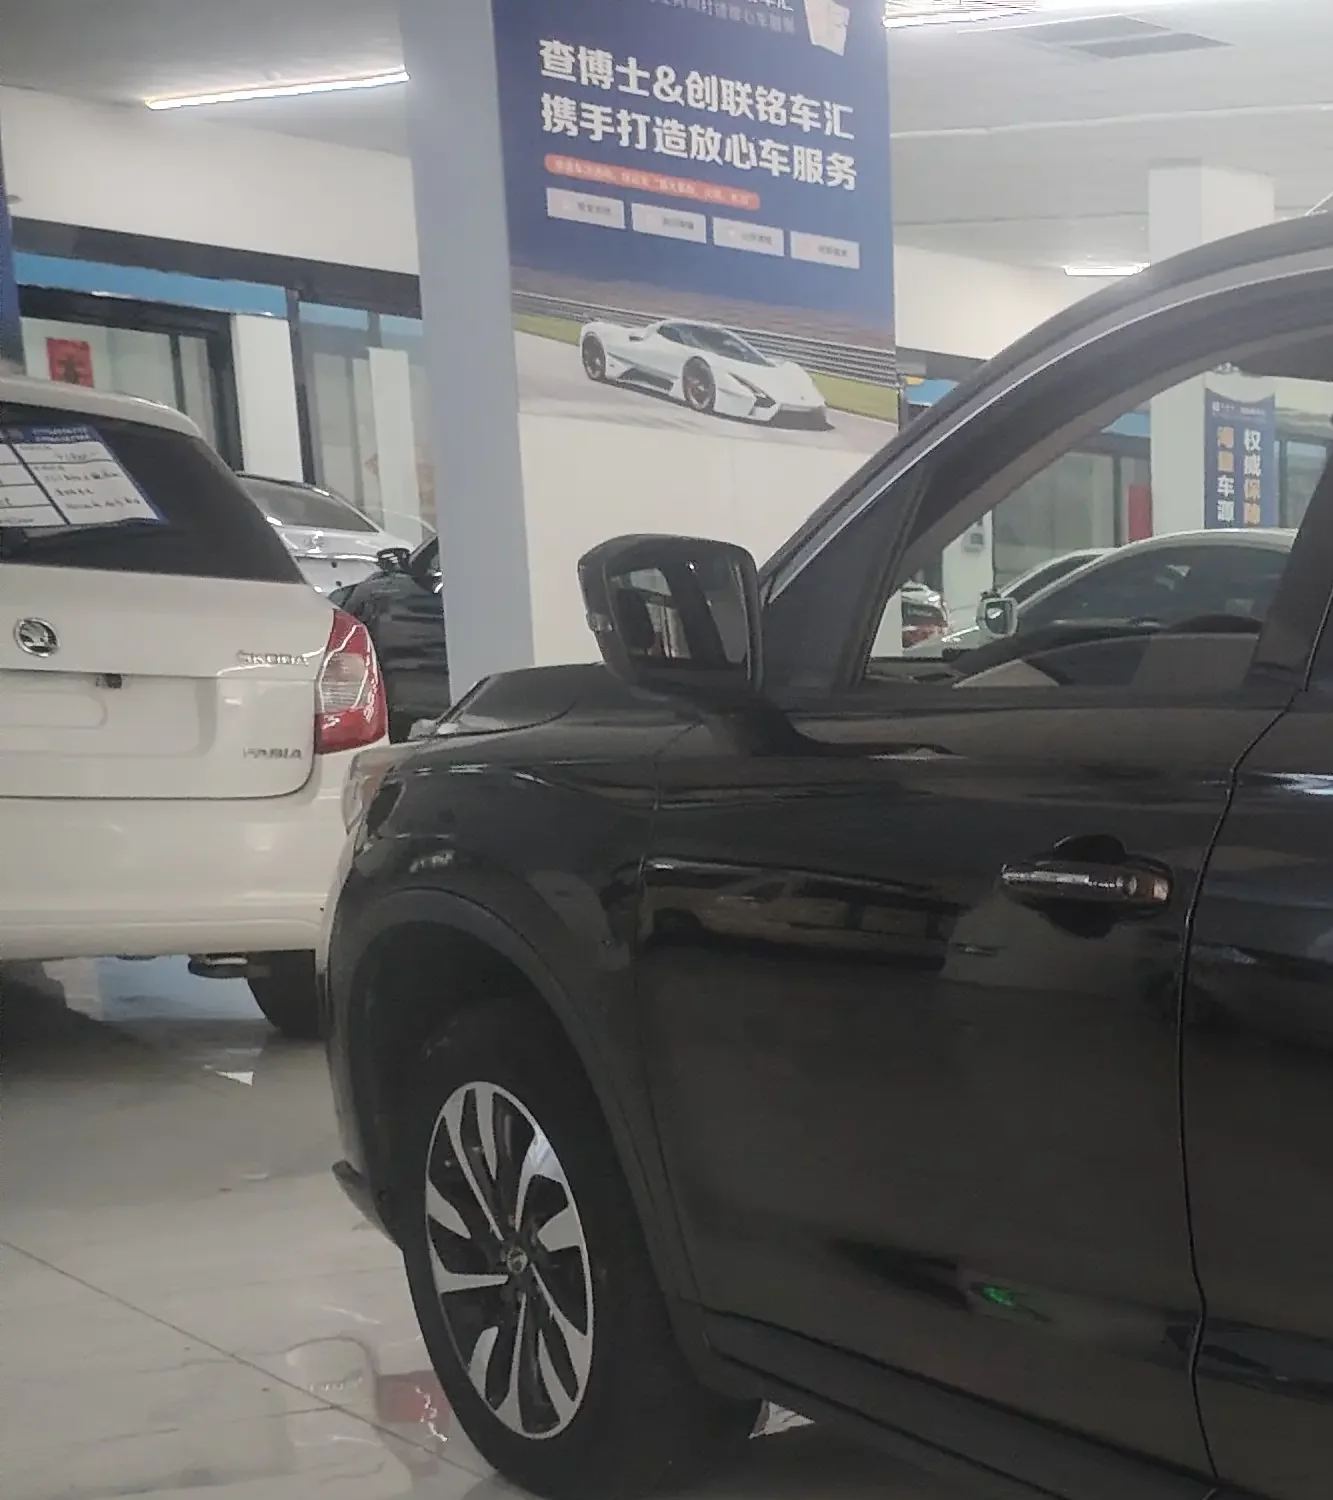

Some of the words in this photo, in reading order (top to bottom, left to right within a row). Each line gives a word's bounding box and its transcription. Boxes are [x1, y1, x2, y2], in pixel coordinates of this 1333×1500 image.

[538, 38, 855, 141] 查博士&创联铭车汇
[540, 92, 858, 191] 携手打造放心车服务
